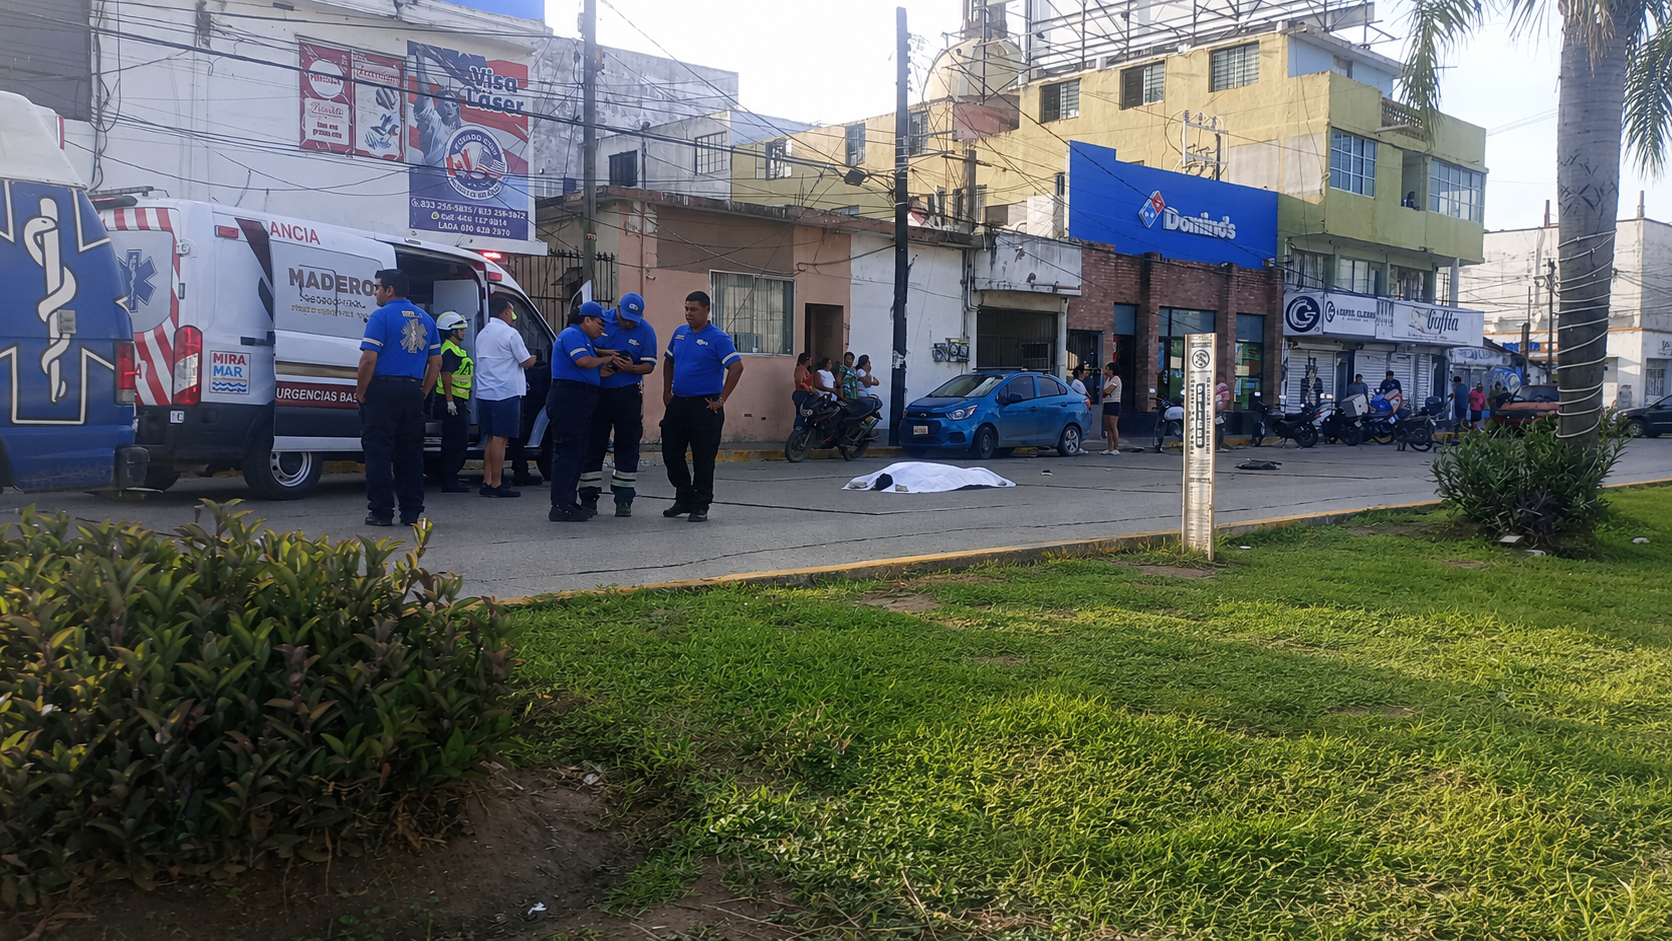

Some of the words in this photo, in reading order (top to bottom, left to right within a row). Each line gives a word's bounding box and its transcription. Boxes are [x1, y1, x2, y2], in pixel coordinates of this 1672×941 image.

[470, 66, 518, 93] Visa
[465, 87, 524, 116] Laser
[270, 221, 321, 246] ANCIA
[1162, 206, 1237, 240] Domino's
[288, 267, 375, 297] MADERO
[213, 352, 247, 366] MIRA
[213, 365, 243, 378] MAR
[276, 387, 338, 402] URGENCIAS
